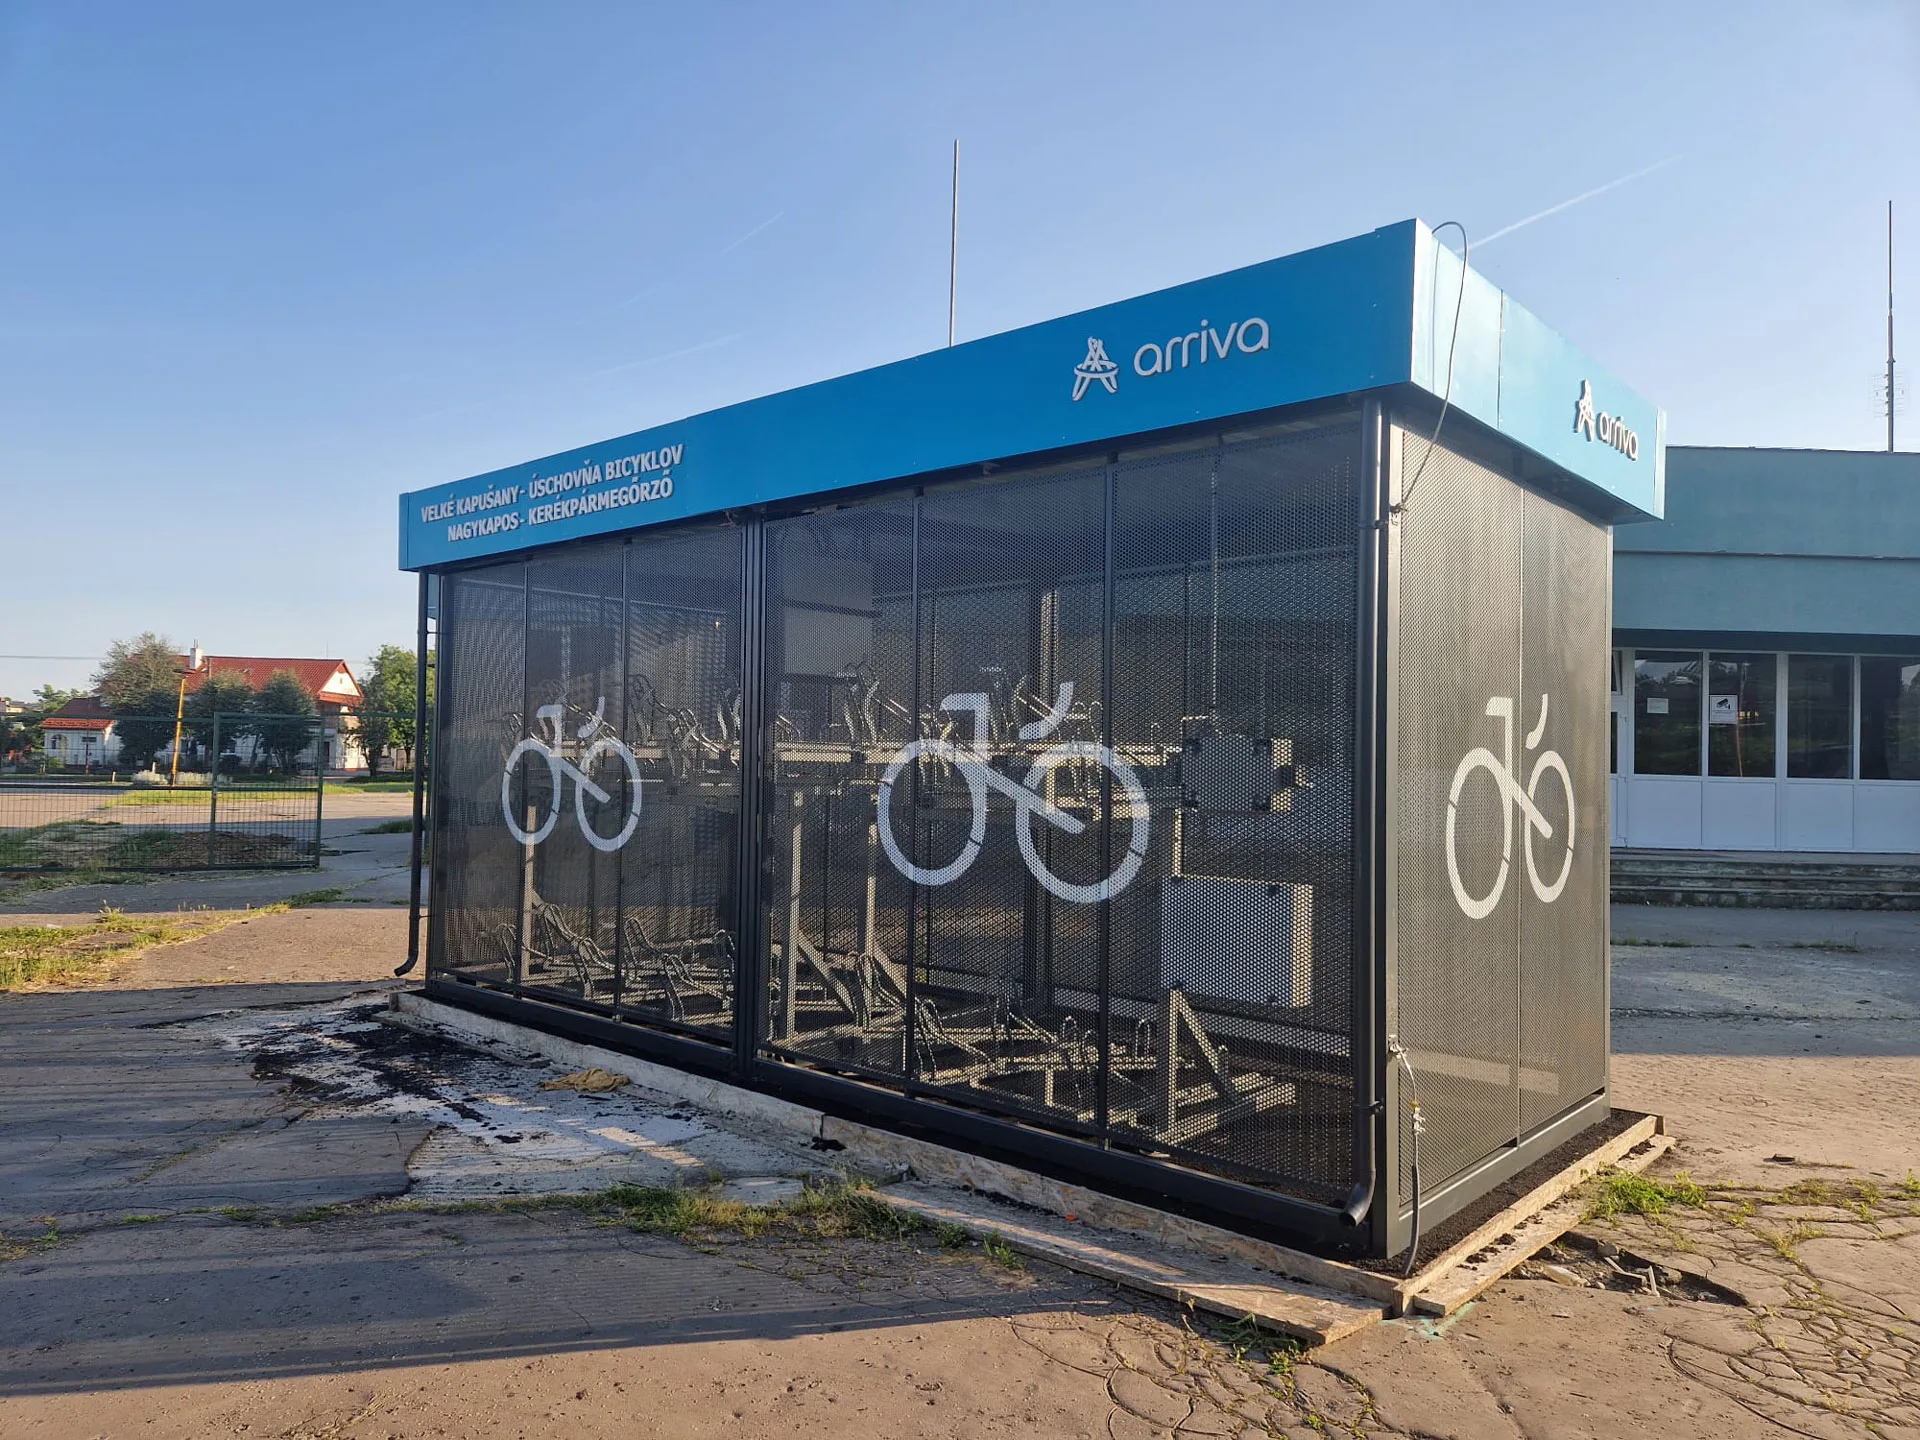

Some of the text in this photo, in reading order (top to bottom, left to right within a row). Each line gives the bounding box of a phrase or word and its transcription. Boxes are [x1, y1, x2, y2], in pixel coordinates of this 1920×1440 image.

[1134, 317, 1269, 376] arriva
[1598, 411, 1639, 461] arriva
[528, 459, 602, 499] ÚSCHOVŇA
[605, 443, 684, 480] BICYKLOV
[528, 470, 674, 526] KERÉKPÁRMEGŐRZŐ
